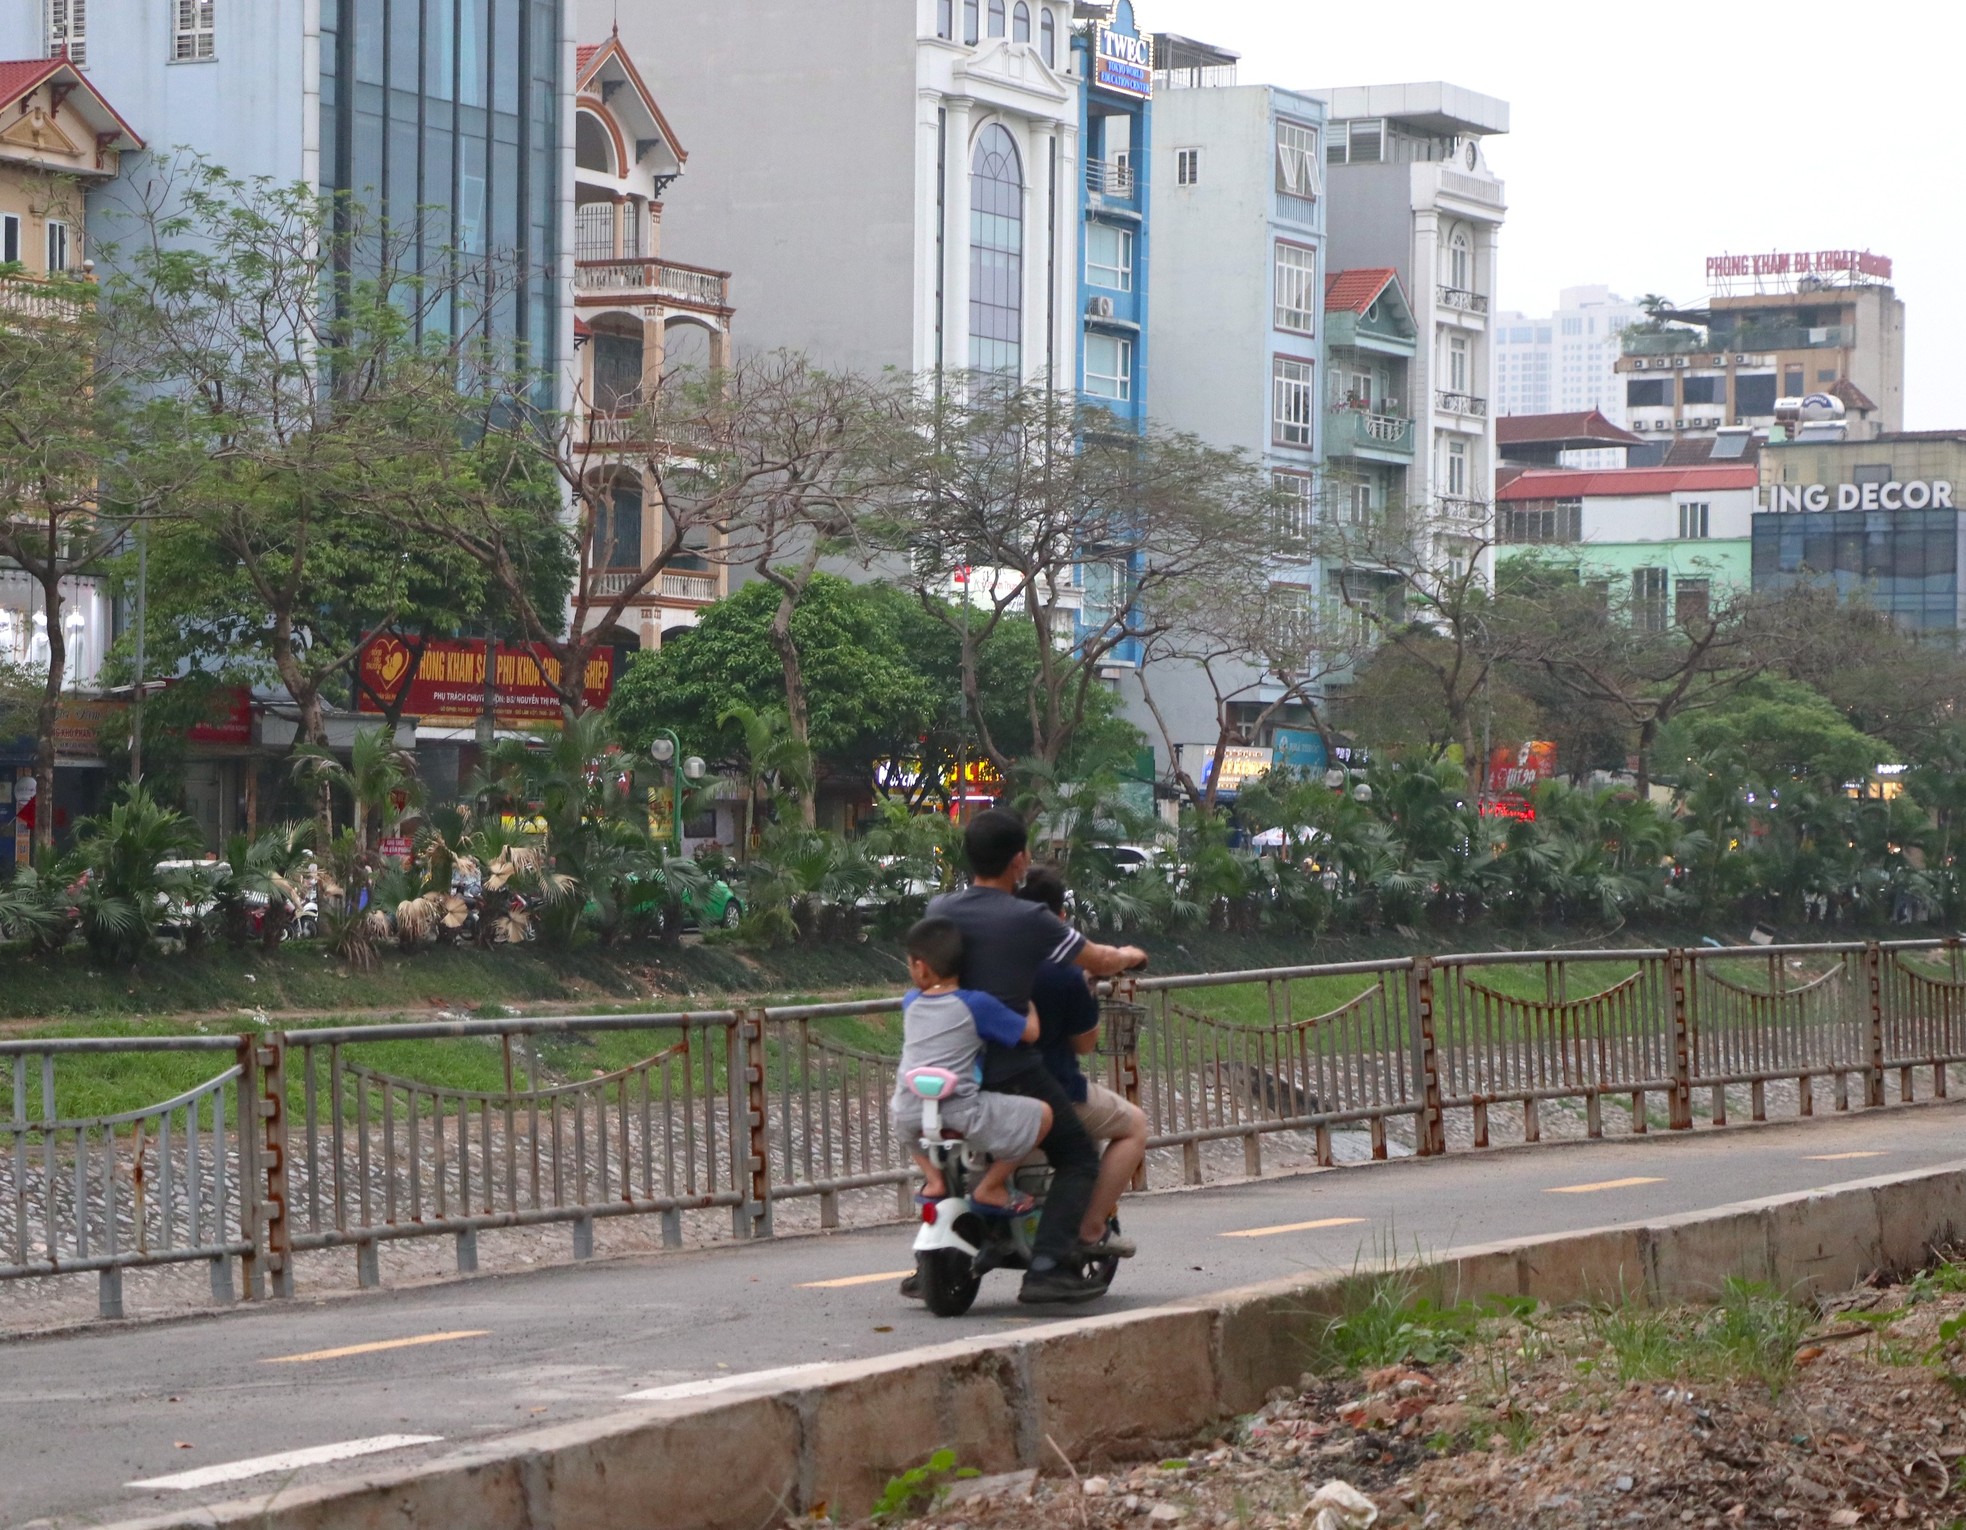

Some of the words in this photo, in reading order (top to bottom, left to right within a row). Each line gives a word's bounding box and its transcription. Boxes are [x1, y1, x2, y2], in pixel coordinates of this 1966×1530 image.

[1104, 30, 1147, 65] TWEC
[1101, 71, 1130, 88] EDUCATION
[1129, 79, 1150, 95] CENTER
[1108, 60, 1126, 75] TOKYO
[1125, 64, 1145, 80] WORLD
[1706, 250, 1750, 278] PHÒNG
[1752, 484, 1830, 514] LING
[1838, 480, 1953, 512] DECOR
[413, 643, 445, 682] HÒNG
[446, 649, 475, 684] KHÁM
[496, 654, 516, 693] PHỤ
[584, 654, 609, 696] GHIỆP
[433, 691, 446, 703] PHỤ
[447, 690, 466, 702] TRÁCH
